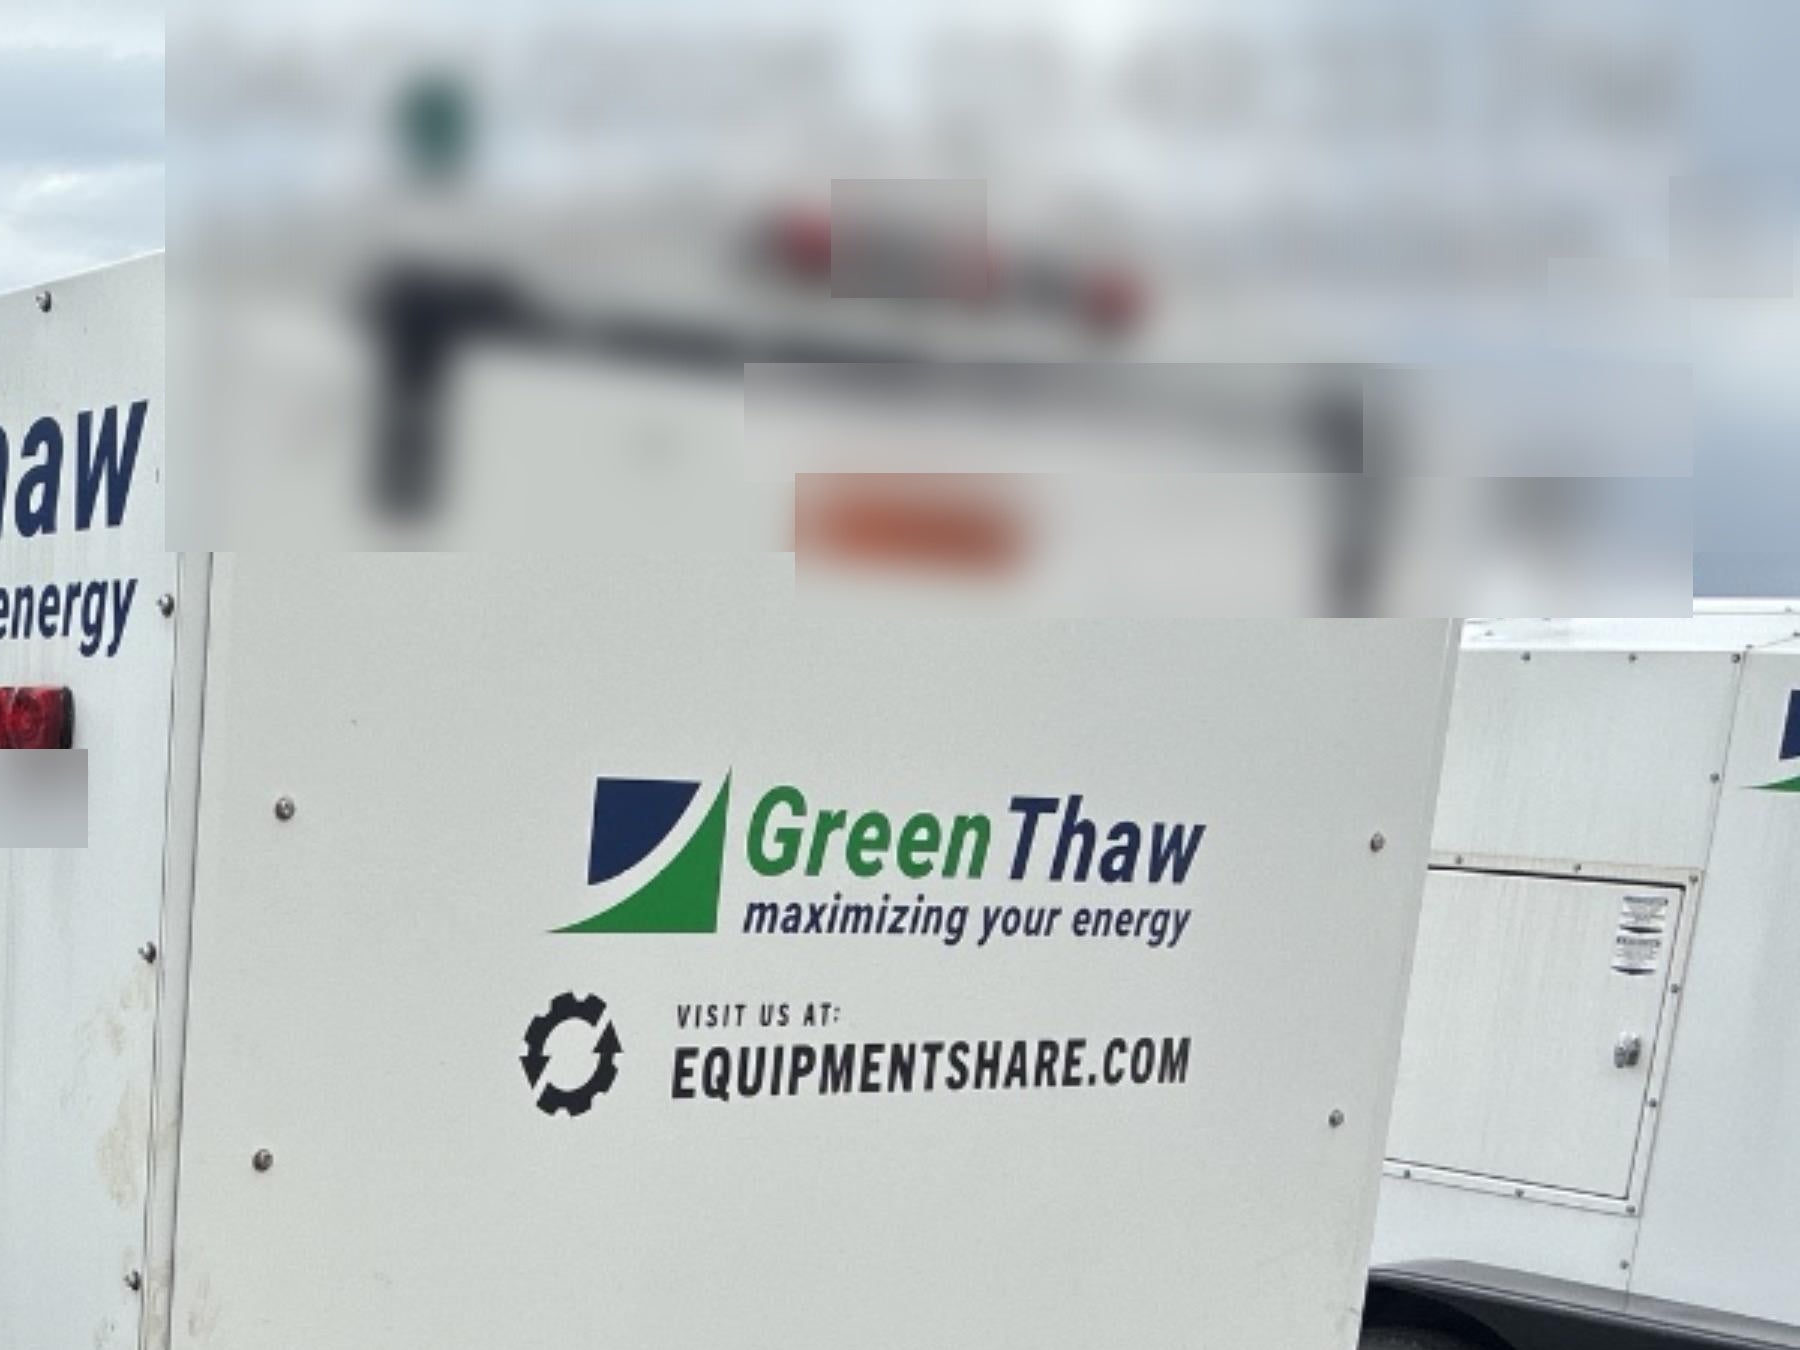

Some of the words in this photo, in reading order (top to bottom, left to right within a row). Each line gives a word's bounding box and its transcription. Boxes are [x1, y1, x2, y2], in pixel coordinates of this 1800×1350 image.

[743, 891, 969, 946] maximizing
[977, 906, 1062, 947] your
[1072, 908, 1191, 948] energy
[677, 1004, 747, 1029] VISIT
[760, 1003, 789, 1027] US
[803, 1002, 840, 1026] AT:
[672, 1037, 1191, 1102] EQUIPMENTSHARE.COM
